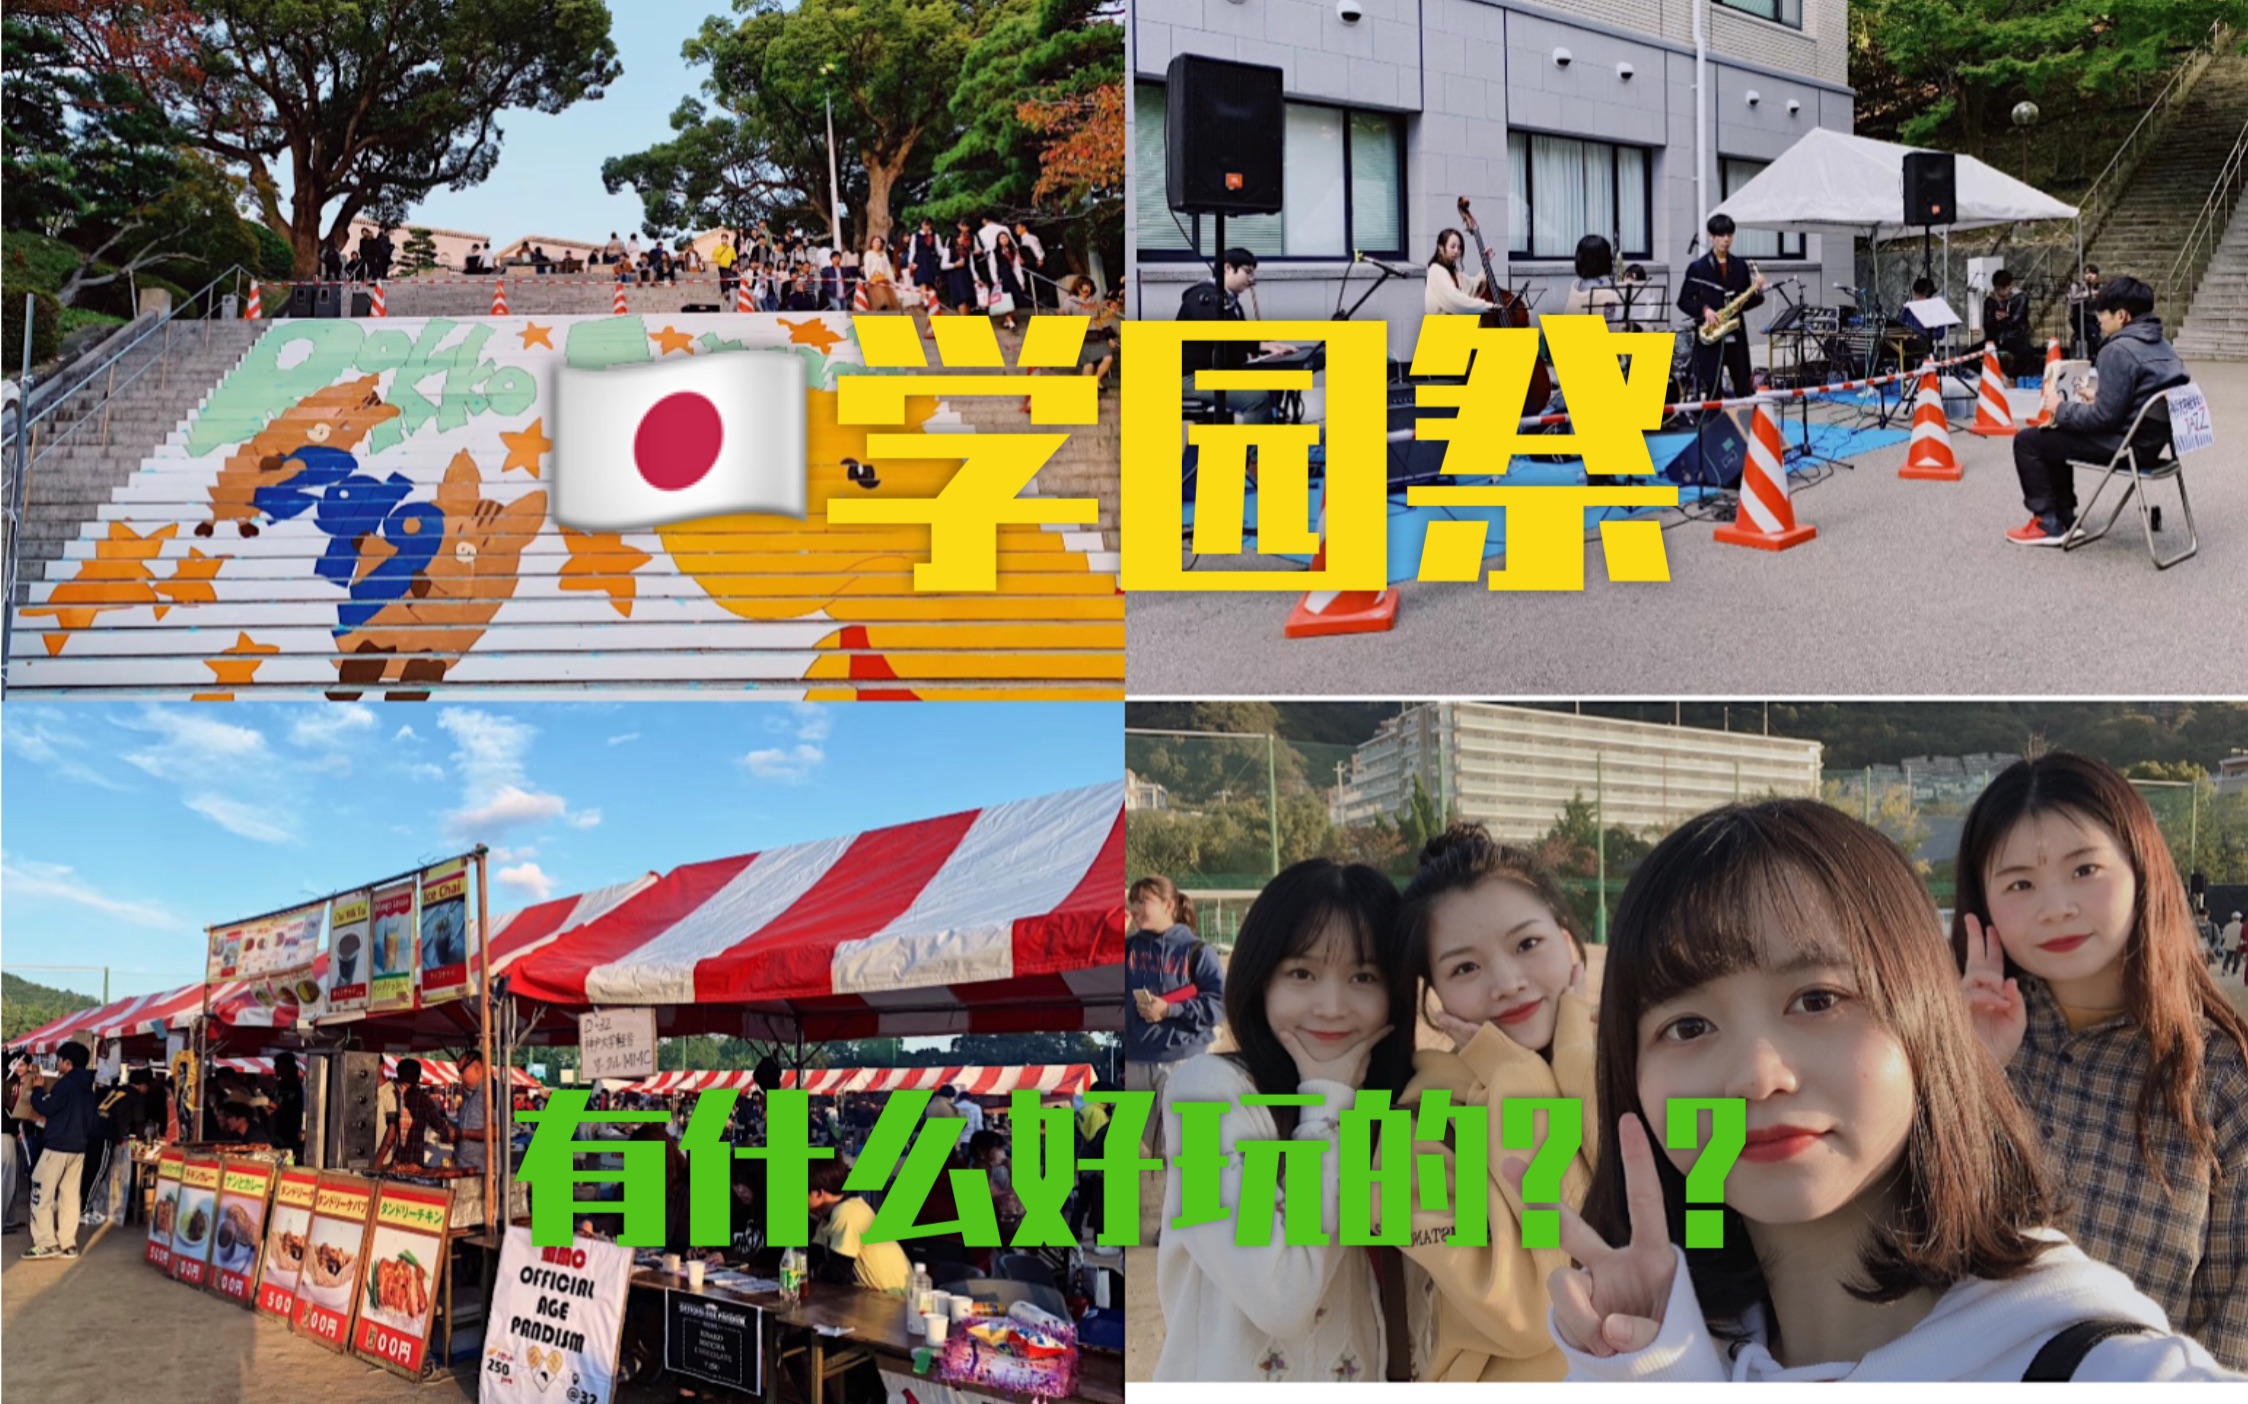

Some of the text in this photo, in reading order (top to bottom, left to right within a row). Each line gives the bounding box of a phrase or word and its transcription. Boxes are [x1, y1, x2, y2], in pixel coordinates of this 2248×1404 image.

[423, 881, 461, 902] Ice Chai
[381, 1202, 443, 1225] タンドリーチキン
[519, 1265, 596, 1300] OFFICIAL
[536, 1295, 570, 1321] AGE
[367, 1324, 412, 1364] 500円
[510, 1315, 586, 1354] PANDISM
[486, 1357, 511, 1377] 250
